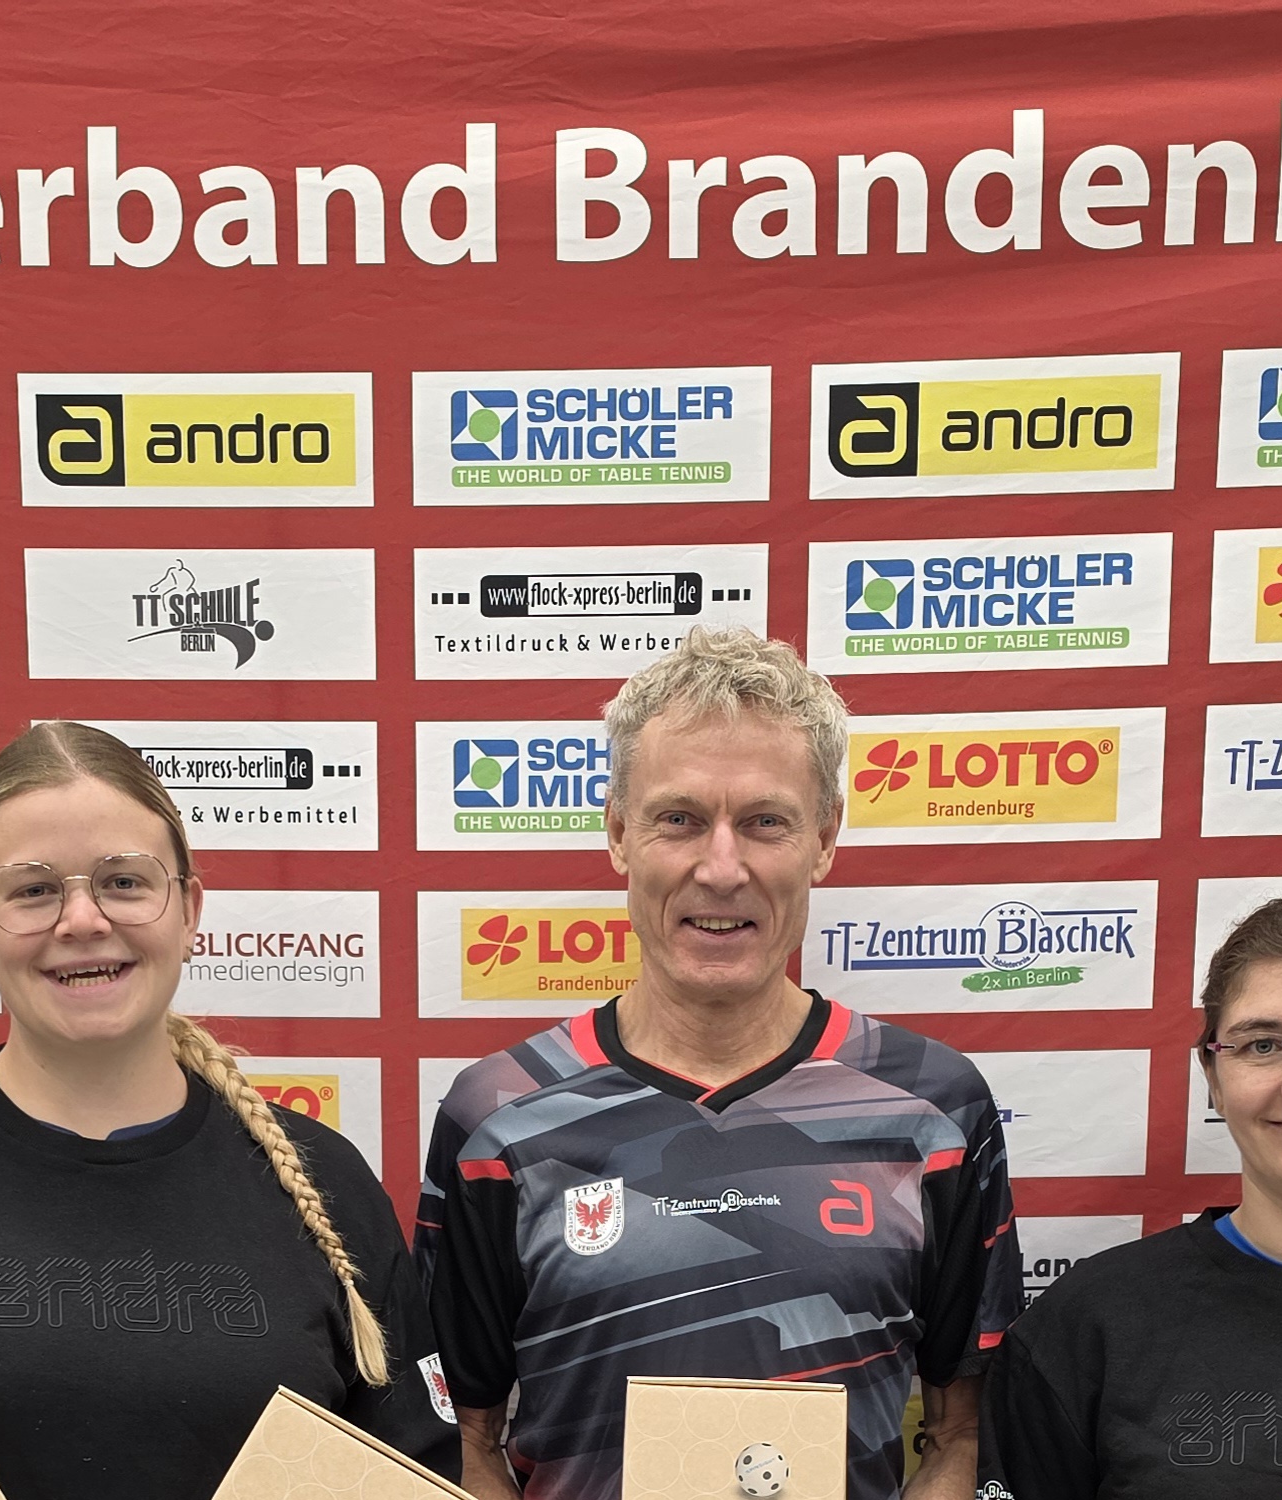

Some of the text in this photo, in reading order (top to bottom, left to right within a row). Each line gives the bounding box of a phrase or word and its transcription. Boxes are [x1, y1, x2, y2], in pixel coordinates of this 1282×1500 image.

[526, 386, 733, 423] SCHÖLER
[941, 397, 1133, 452] andro
[146, 413, 330, 464] andro
[527, 426, 678, 461] MICKE
[456, 465, 726, 484] THE WORLD OF TABLE TENNIS
[922, 552, 1133, 589] SCHÖLER
[488, 580, 696, 609] www.flock-xpress-berlin.de
[923, 591, 1075, 628] MICKE
[180, 633, 216, 653] BERLIN
[435, 633, 590, 654] Textildruck &
[851, 629, 1123, 653] THE WORLD OF TABLE TENNIS
[191, 805, 358, 825] & Werbemittel
[926, 798, 1035, 820] Brandenburg
[459, 814, 591, 830] THE WORLD OF
[192, 932, 365, 959] BLICKFANG
[821, 909, 1135, 971] TT-Zentrum Blaschek
[189, 959, 365, 988] mediendesign
[982, 968, 1071, 989] 2x in Berlin
[574, 1182, 614, 1197] TTVB
[652, 1194, 781, 1217] TT-Zentrum Blaschek
